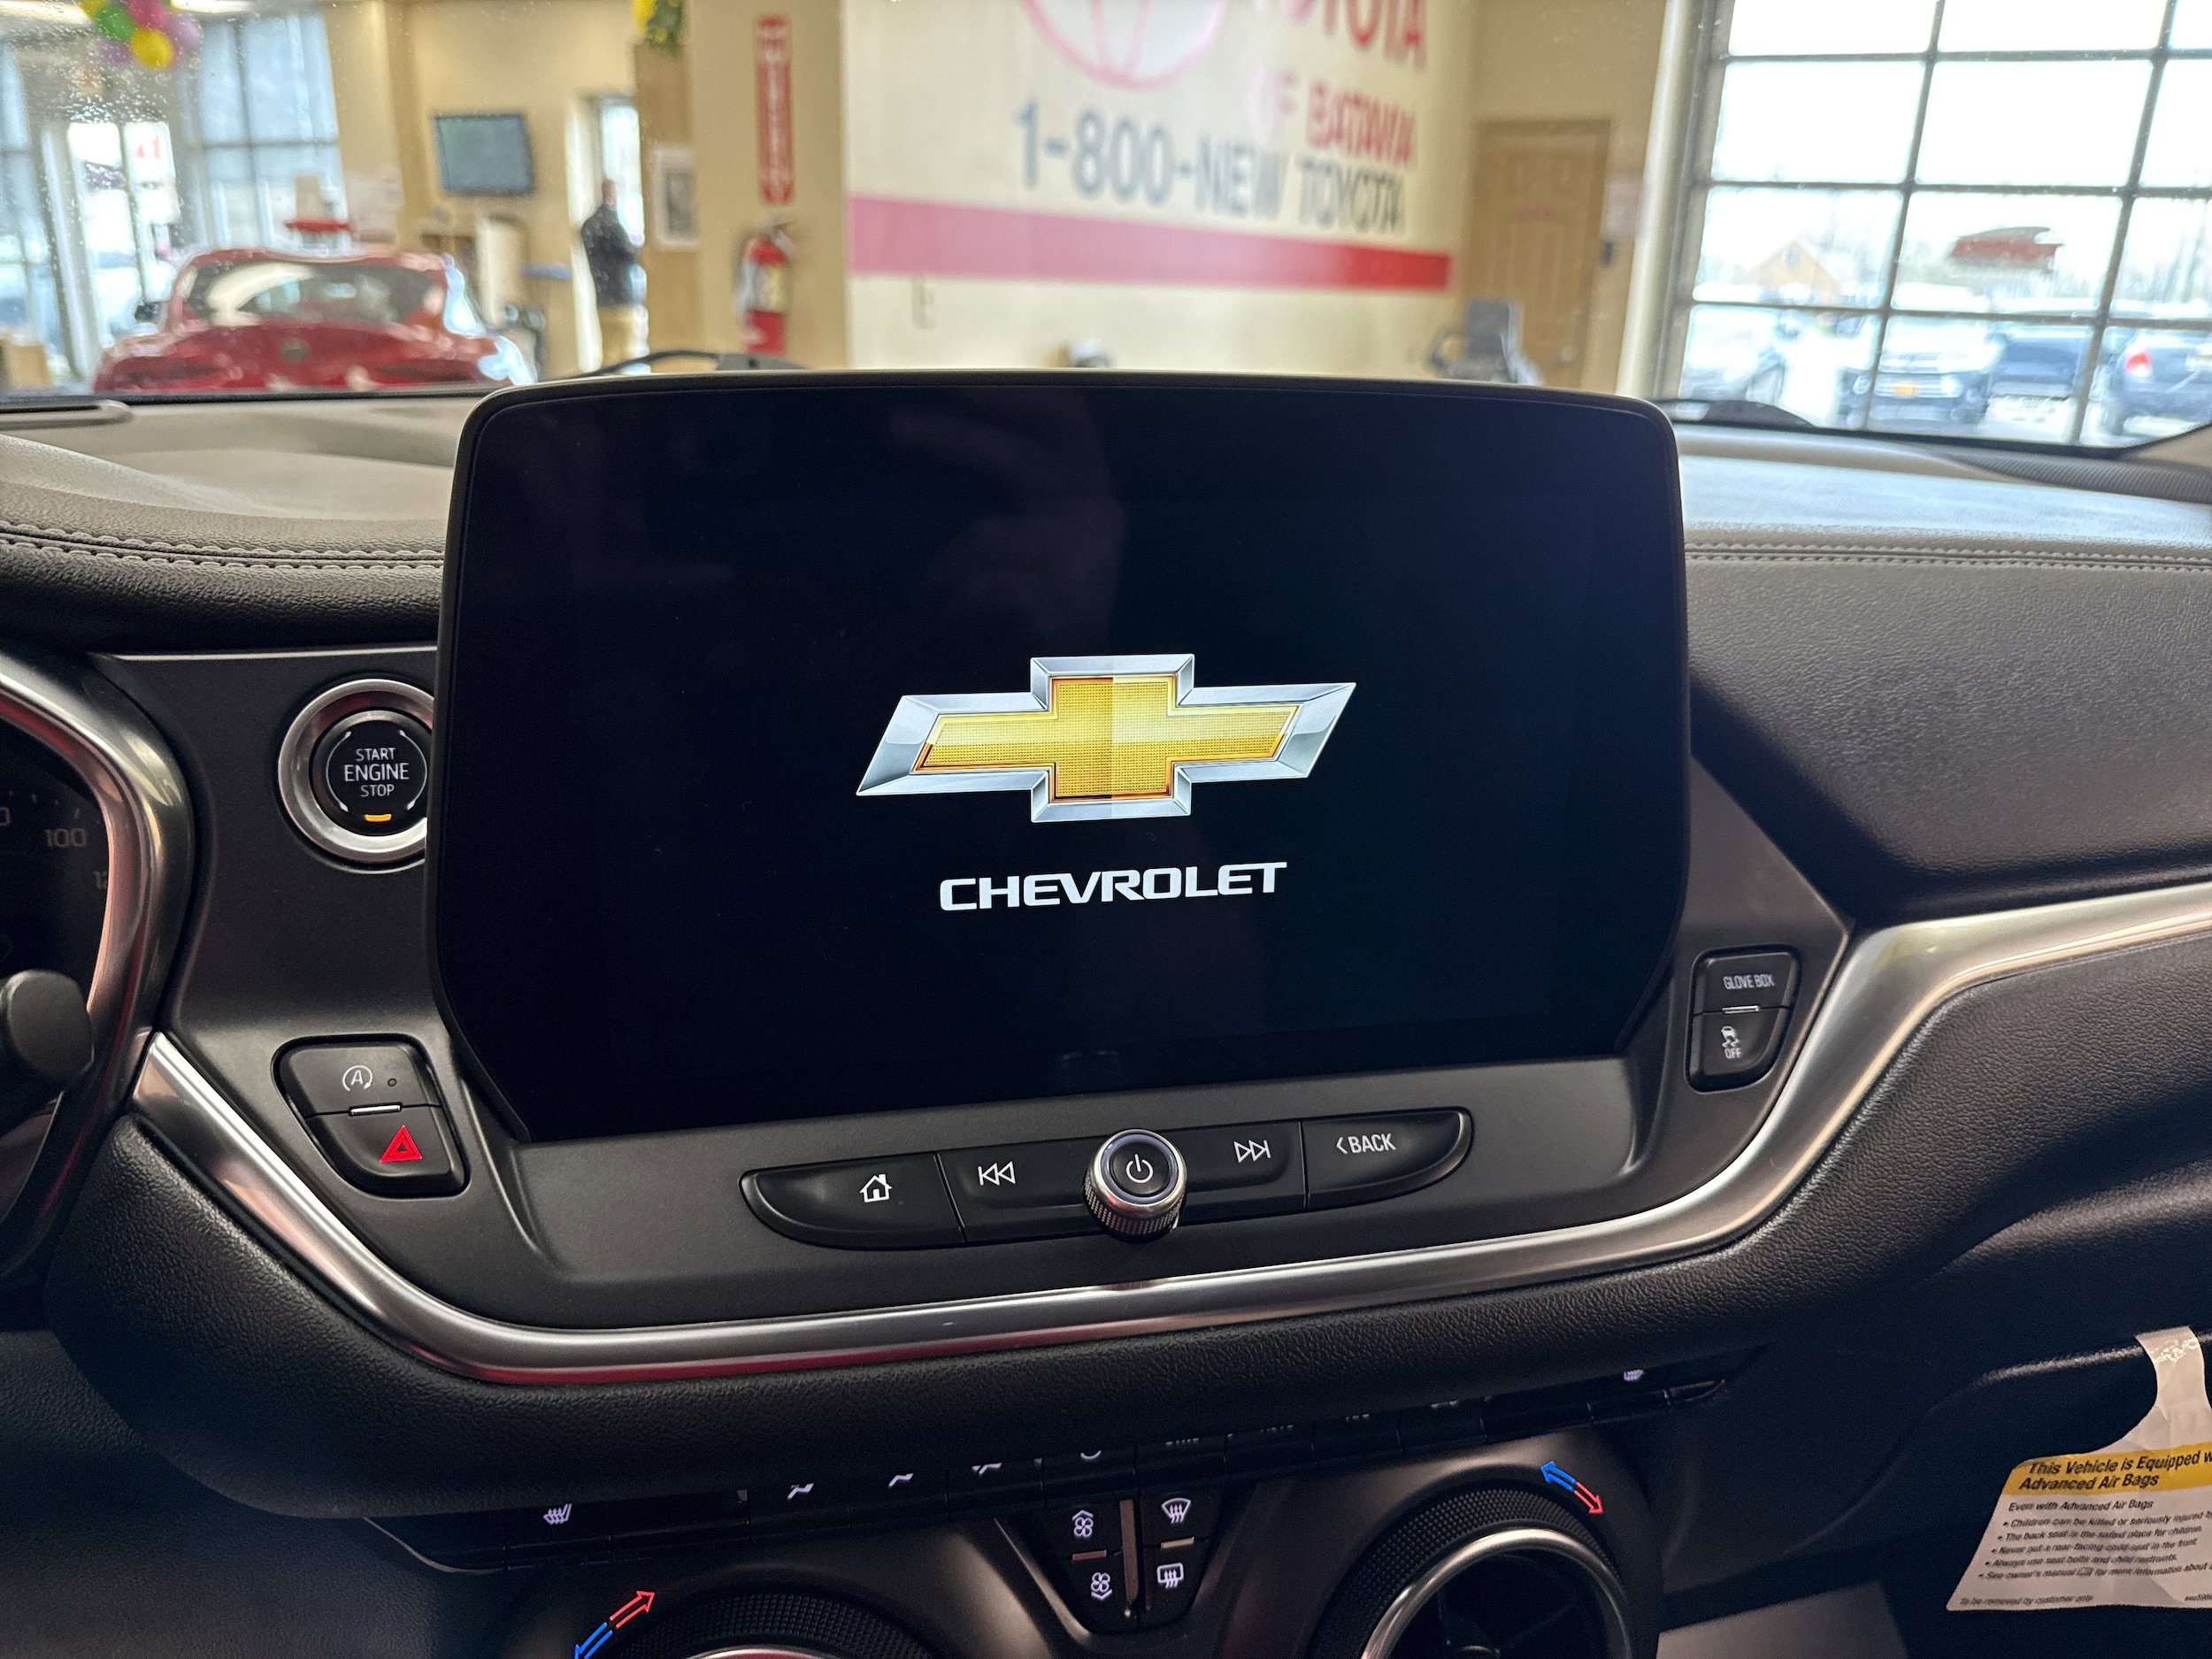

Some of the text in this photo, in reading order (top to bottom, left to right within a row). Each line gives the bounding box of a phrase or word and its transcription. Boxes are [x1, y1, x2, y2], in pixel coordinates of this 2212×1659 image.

[356, 747, 396, 762] START
[343, 762, 410, 782] ENGINE
[360, 784, 395, 797] STOP
[45, 827, 87, 848] 100
[940, 861, 1287, 910] CHEVROLET
[1723, 973, 1775, 989] GLOVE BOX
[1724, 1048, 1742, 1059] OFF
[2030, 1462, 2062, 1474] This
[2066, 1459, 2118, 1474] Vehicle
[2121, 1457, 2133, 1471] is
[2136, 1450, 2200, 1471] Equipped
[2018, 1473, 2159, 1490] Advanced Air Bags
[2008, 1499, 2154, 1511] Even with Advanced Air Bags
[2010, 1518, 2050, 1527] Children
[2130, 1514, 2171, 1525] seriously
[2173, 1511, 2203, 1522] injured
[2006, 1532, 2023, 1541] The
[2024, 1531, 2045, 1540] back
[2127, 1530, 2152, 1539] place
[2183, 1563, 2208, 1571] about
